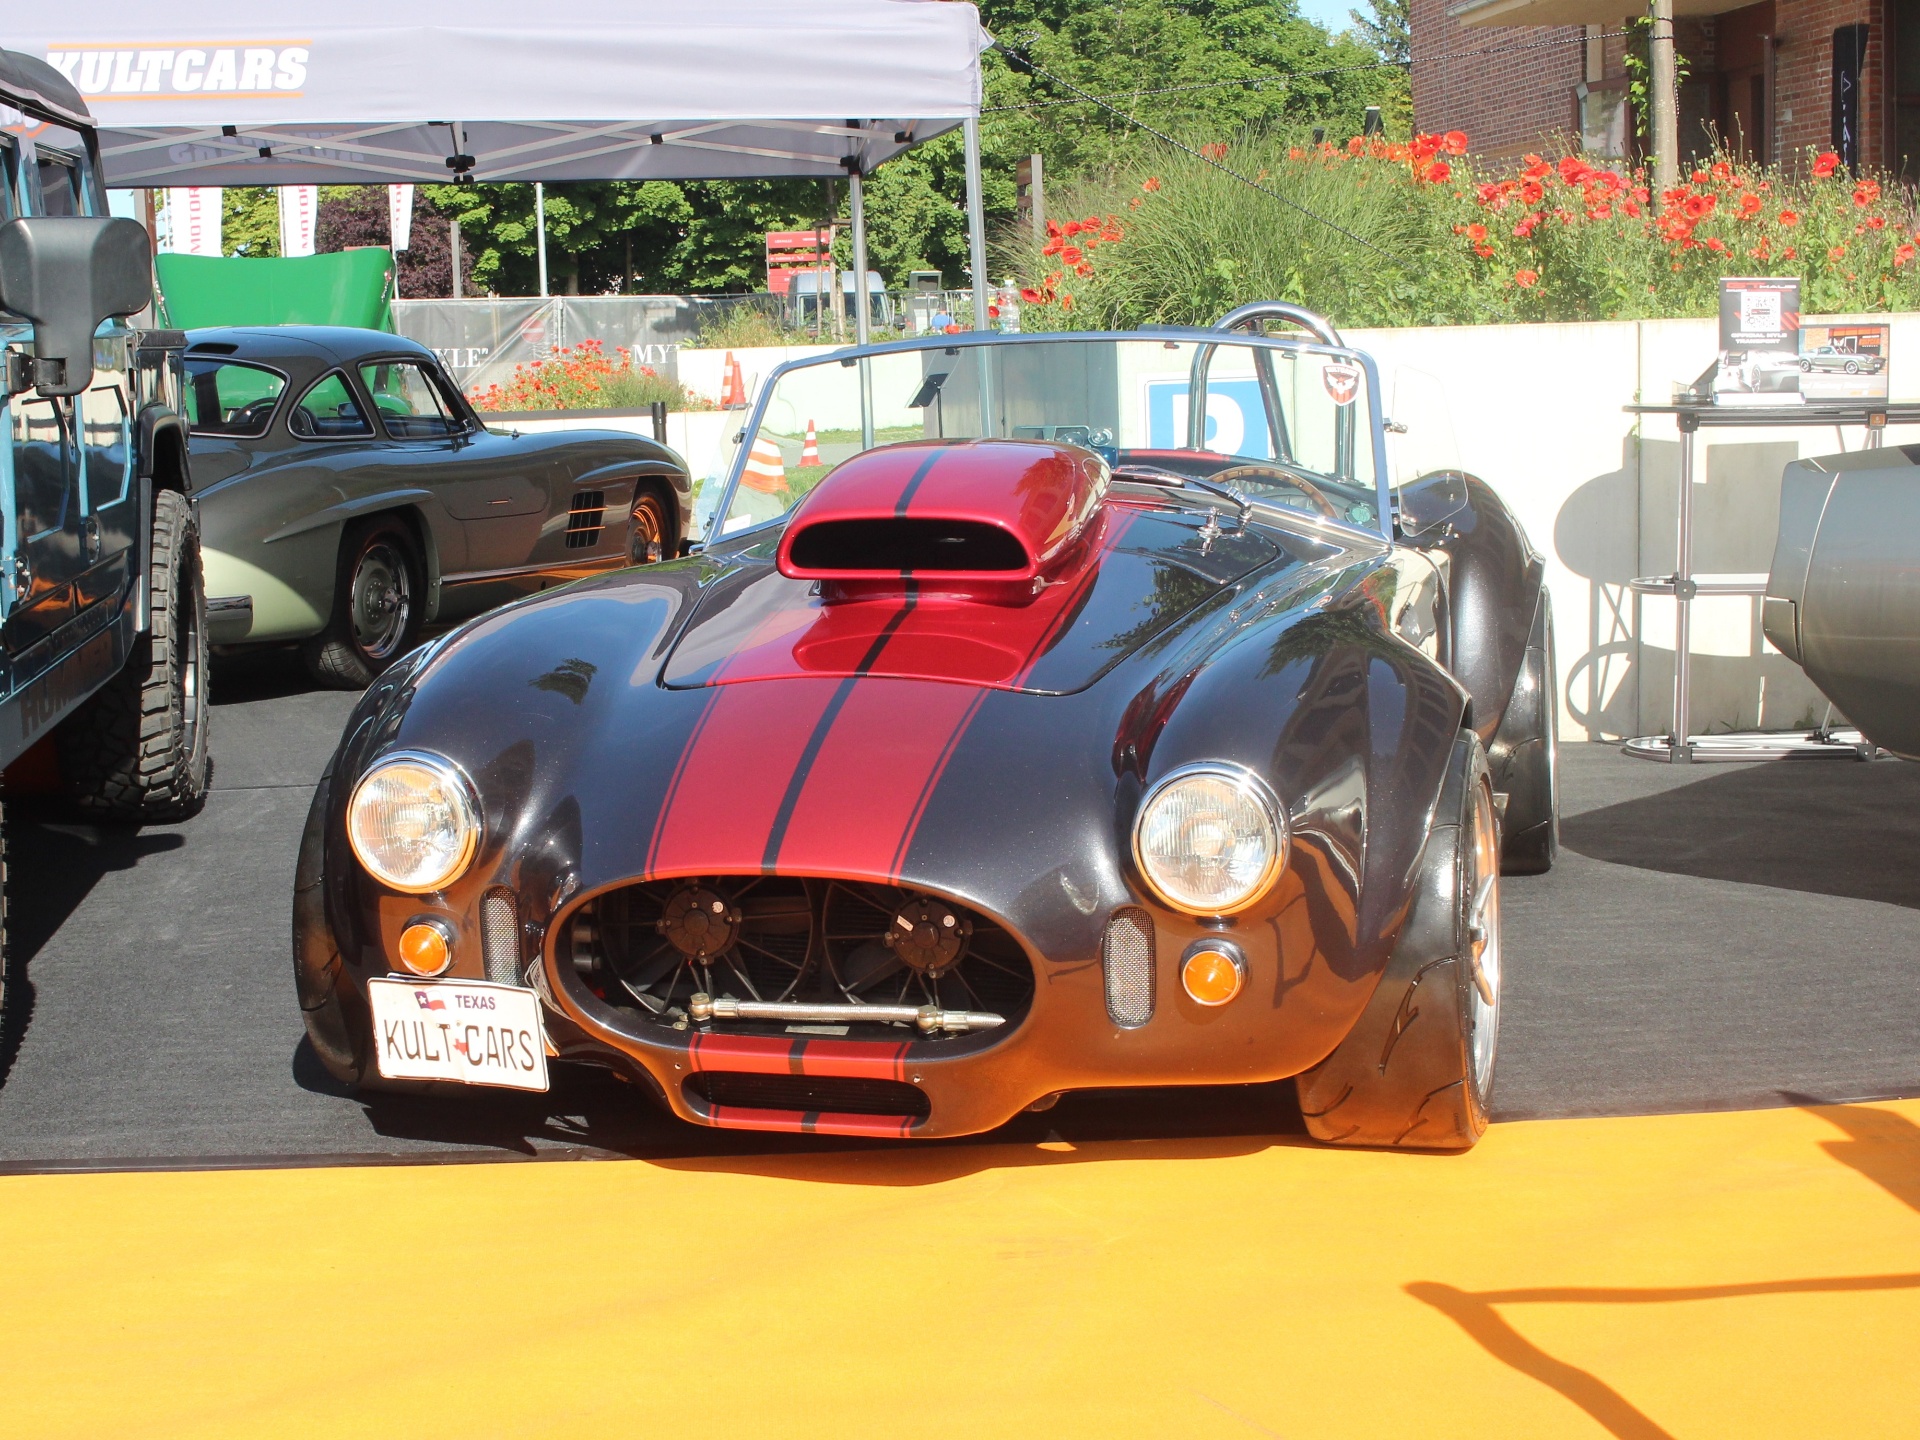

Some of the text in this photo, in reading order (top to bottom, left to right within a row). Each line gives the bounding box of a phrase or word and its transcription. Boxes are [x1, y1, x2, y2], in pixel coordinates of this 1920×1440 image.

[47, 47, 309, 95] KULTCARS
[455, 994, 496, 1011] TEXAS
[383, 1019, 535, 1072] KULT CARS
